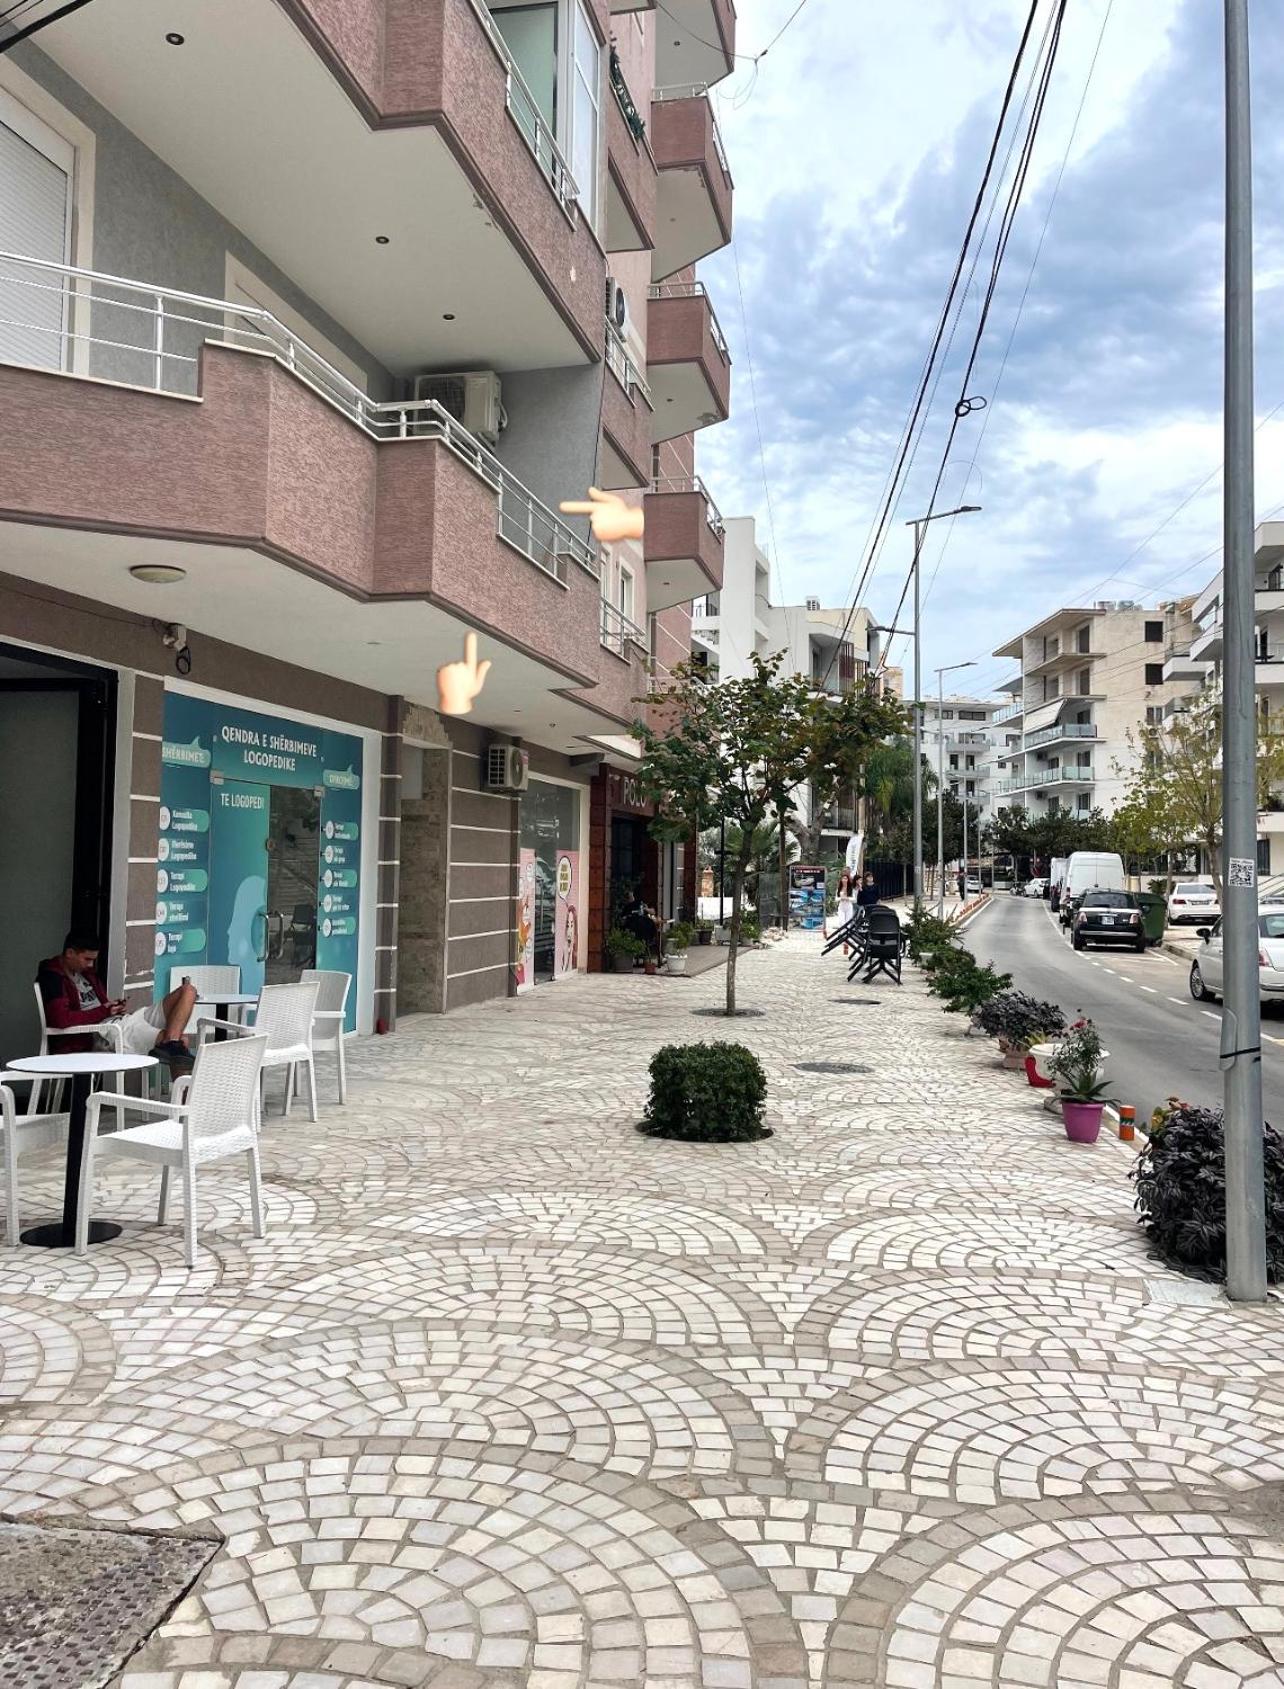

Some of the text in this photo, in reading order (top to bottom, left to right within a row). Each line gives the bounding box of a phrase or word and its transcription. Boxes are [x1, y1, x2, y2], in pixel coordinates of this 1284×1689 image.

[221, 726, 318, 758] QENDRA E SHËRBIMEVE
[244, 750, 296, 772] LOGOPEDIKE
[221, 793, 230, 806] TE
